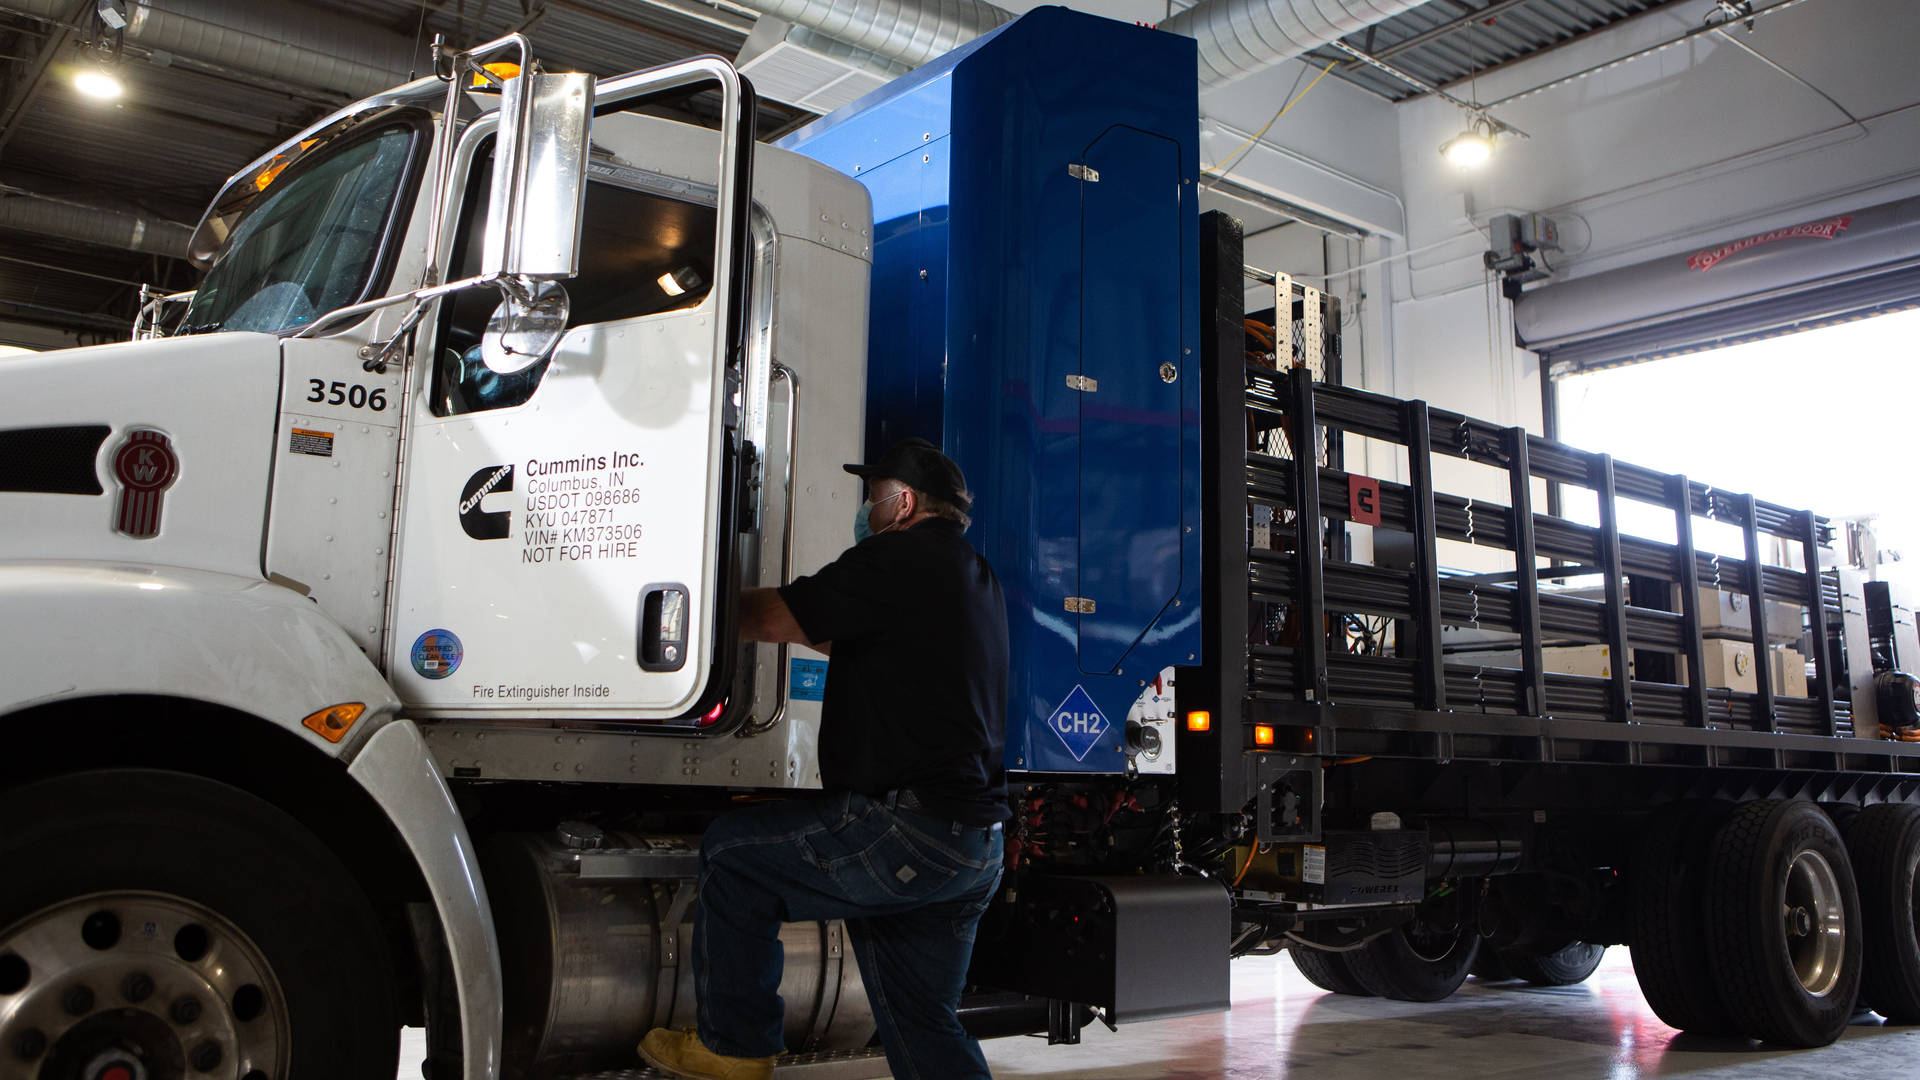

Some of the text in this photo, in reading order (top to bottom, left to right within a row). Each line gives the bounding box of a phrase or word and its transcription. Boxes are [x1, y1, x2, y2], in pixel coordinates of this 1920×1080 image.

[1702, 224, 1833, 266] OVERHEAD DOOR
[307, 378, 387, 412] 3506
[526, 451, 645, 477] Cummins Inc.
[459, 464, 512, 515] Cummins
[527, 471, 625, 495] Columbus, IN
[526, 488, 641, 512] USDOT 098686
[525, 508, 614, 529] KYU 047871
[524, 523, 643, 546] VIN# KM373506
[522, 541, 638, 564] NOT FOR HIRE
[418, 653, 440, 661] CLEAN
[473, 684, 610, 701] Fire Extinguisher Inside
[1057, 711, 1101, 734] CH2
[1350, 884, 1400, 895] POWEREX
